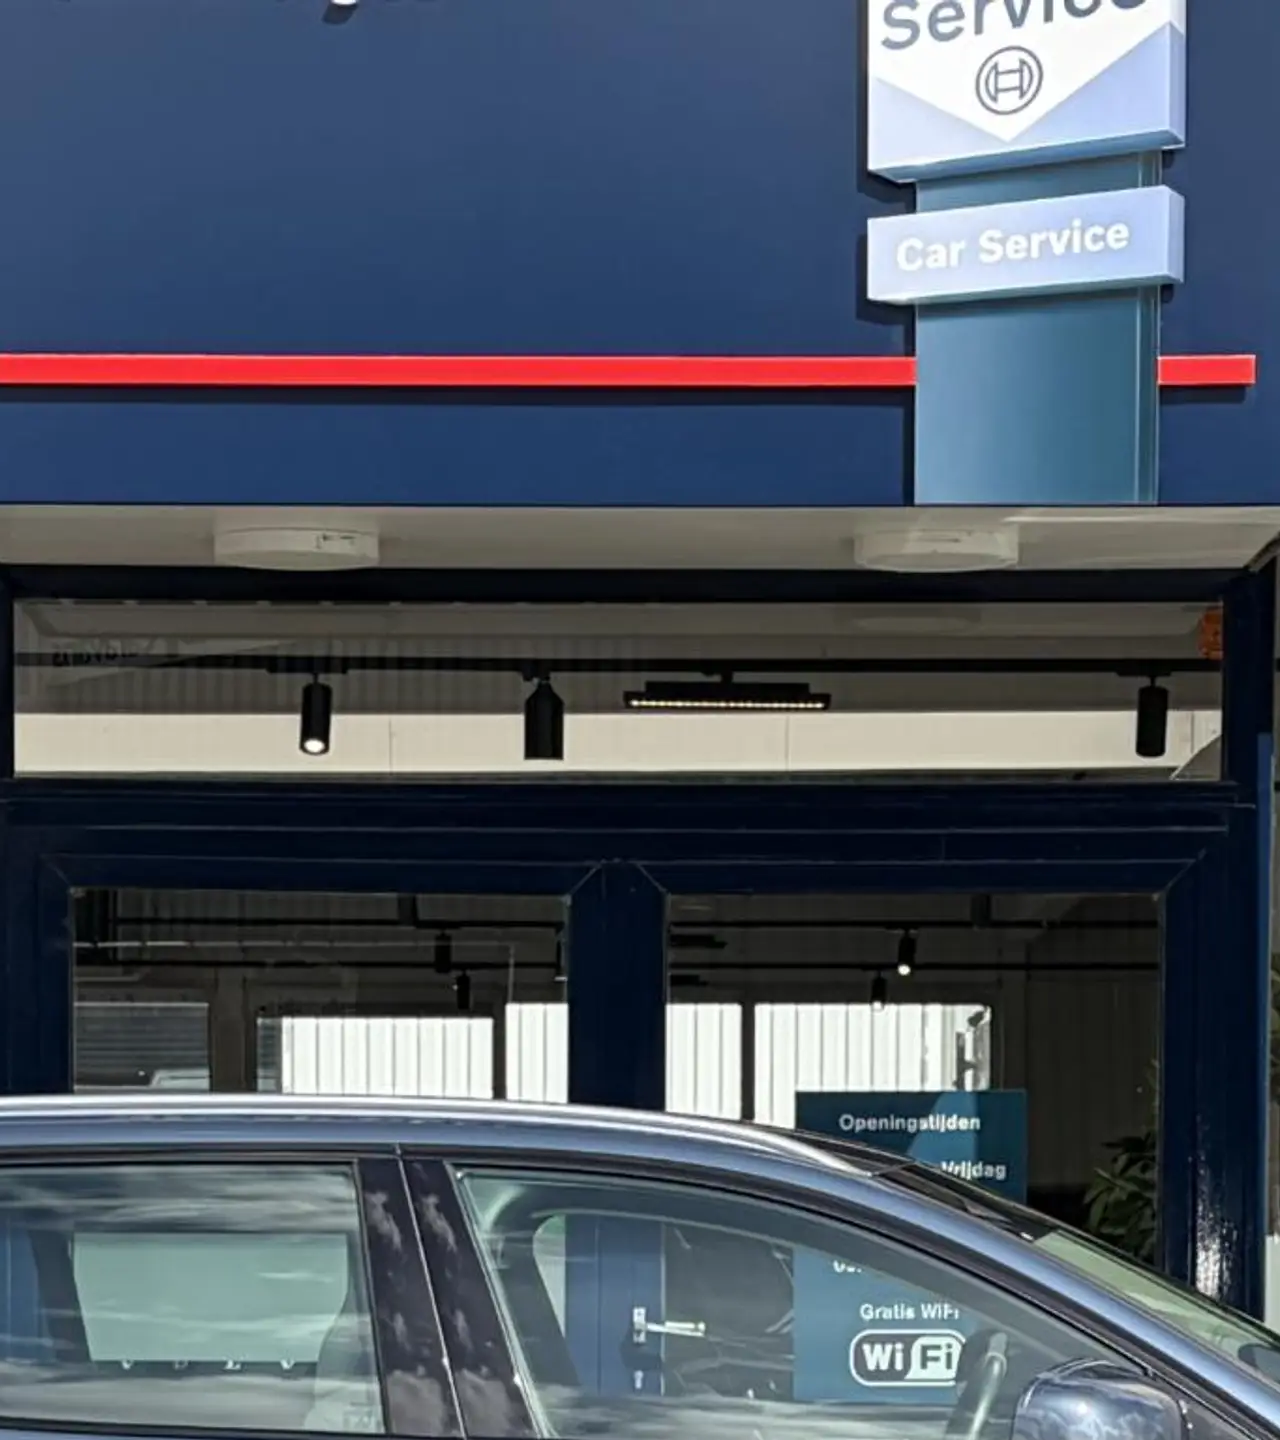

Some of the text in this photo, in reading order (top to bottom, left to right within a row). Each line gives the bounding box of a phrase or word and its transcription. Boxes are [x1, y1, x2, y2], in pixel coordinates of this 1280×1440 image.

[896, 217, 1130, 272] Car Service
[838, 1114, 981, 1133] Openingstijden
[859, 1303, 916, 1321] Gratis
